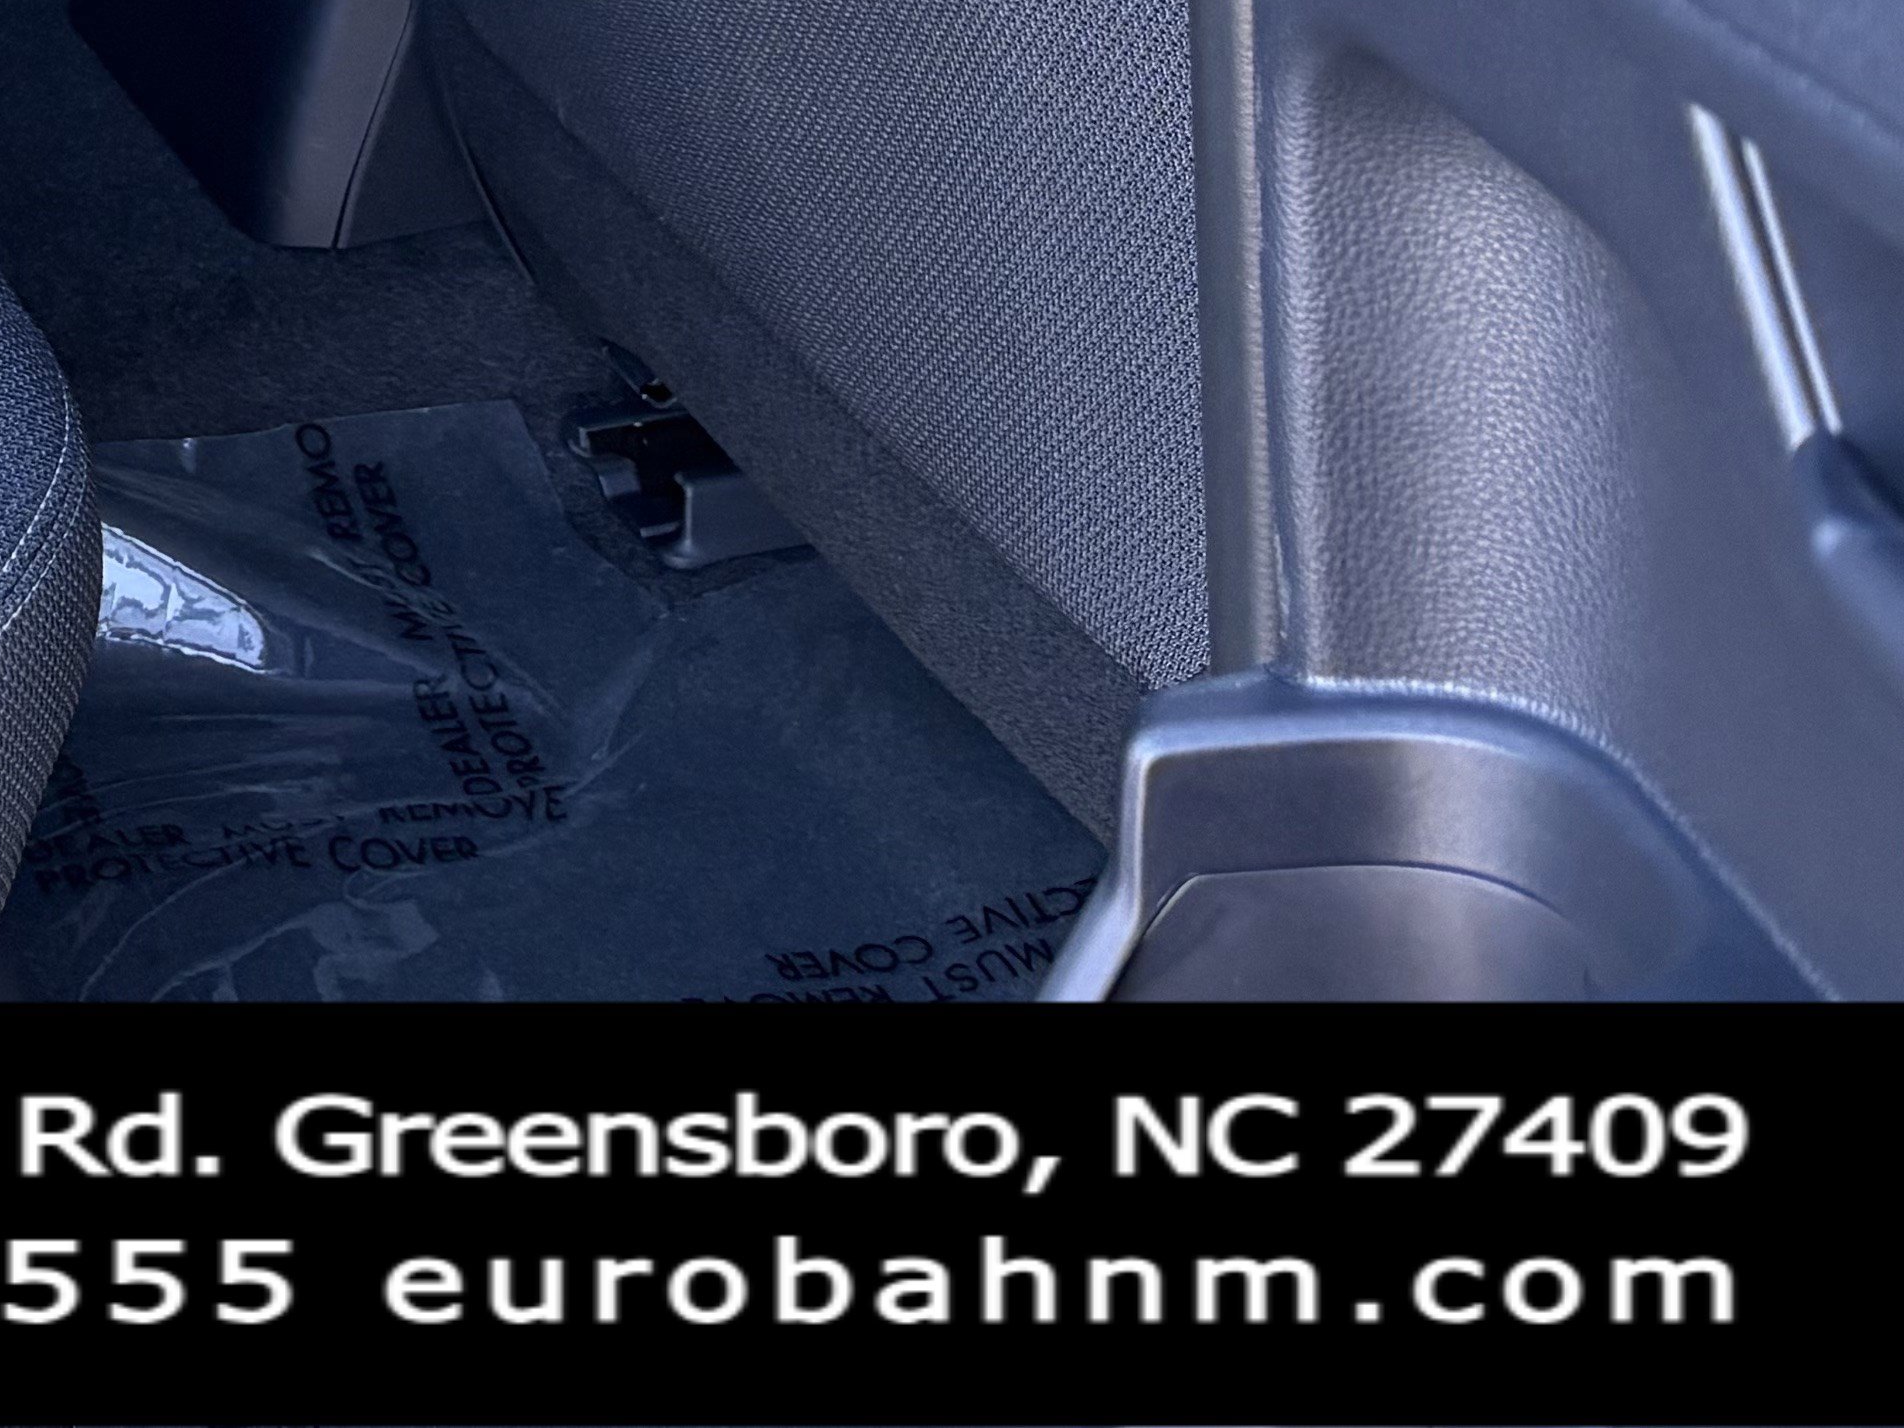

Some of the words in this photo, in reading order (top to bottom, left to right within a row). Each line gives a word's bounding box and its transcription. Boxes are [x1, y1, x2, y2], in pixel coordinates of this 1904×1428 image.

[353, 460, 433, 588] COVER
[412, 671, 504, 796] DEALER
[328, 833, 479, 873] COVER
[765, 935, 935, 981] COVER
[922, 937, 1056, 1002] MUST
